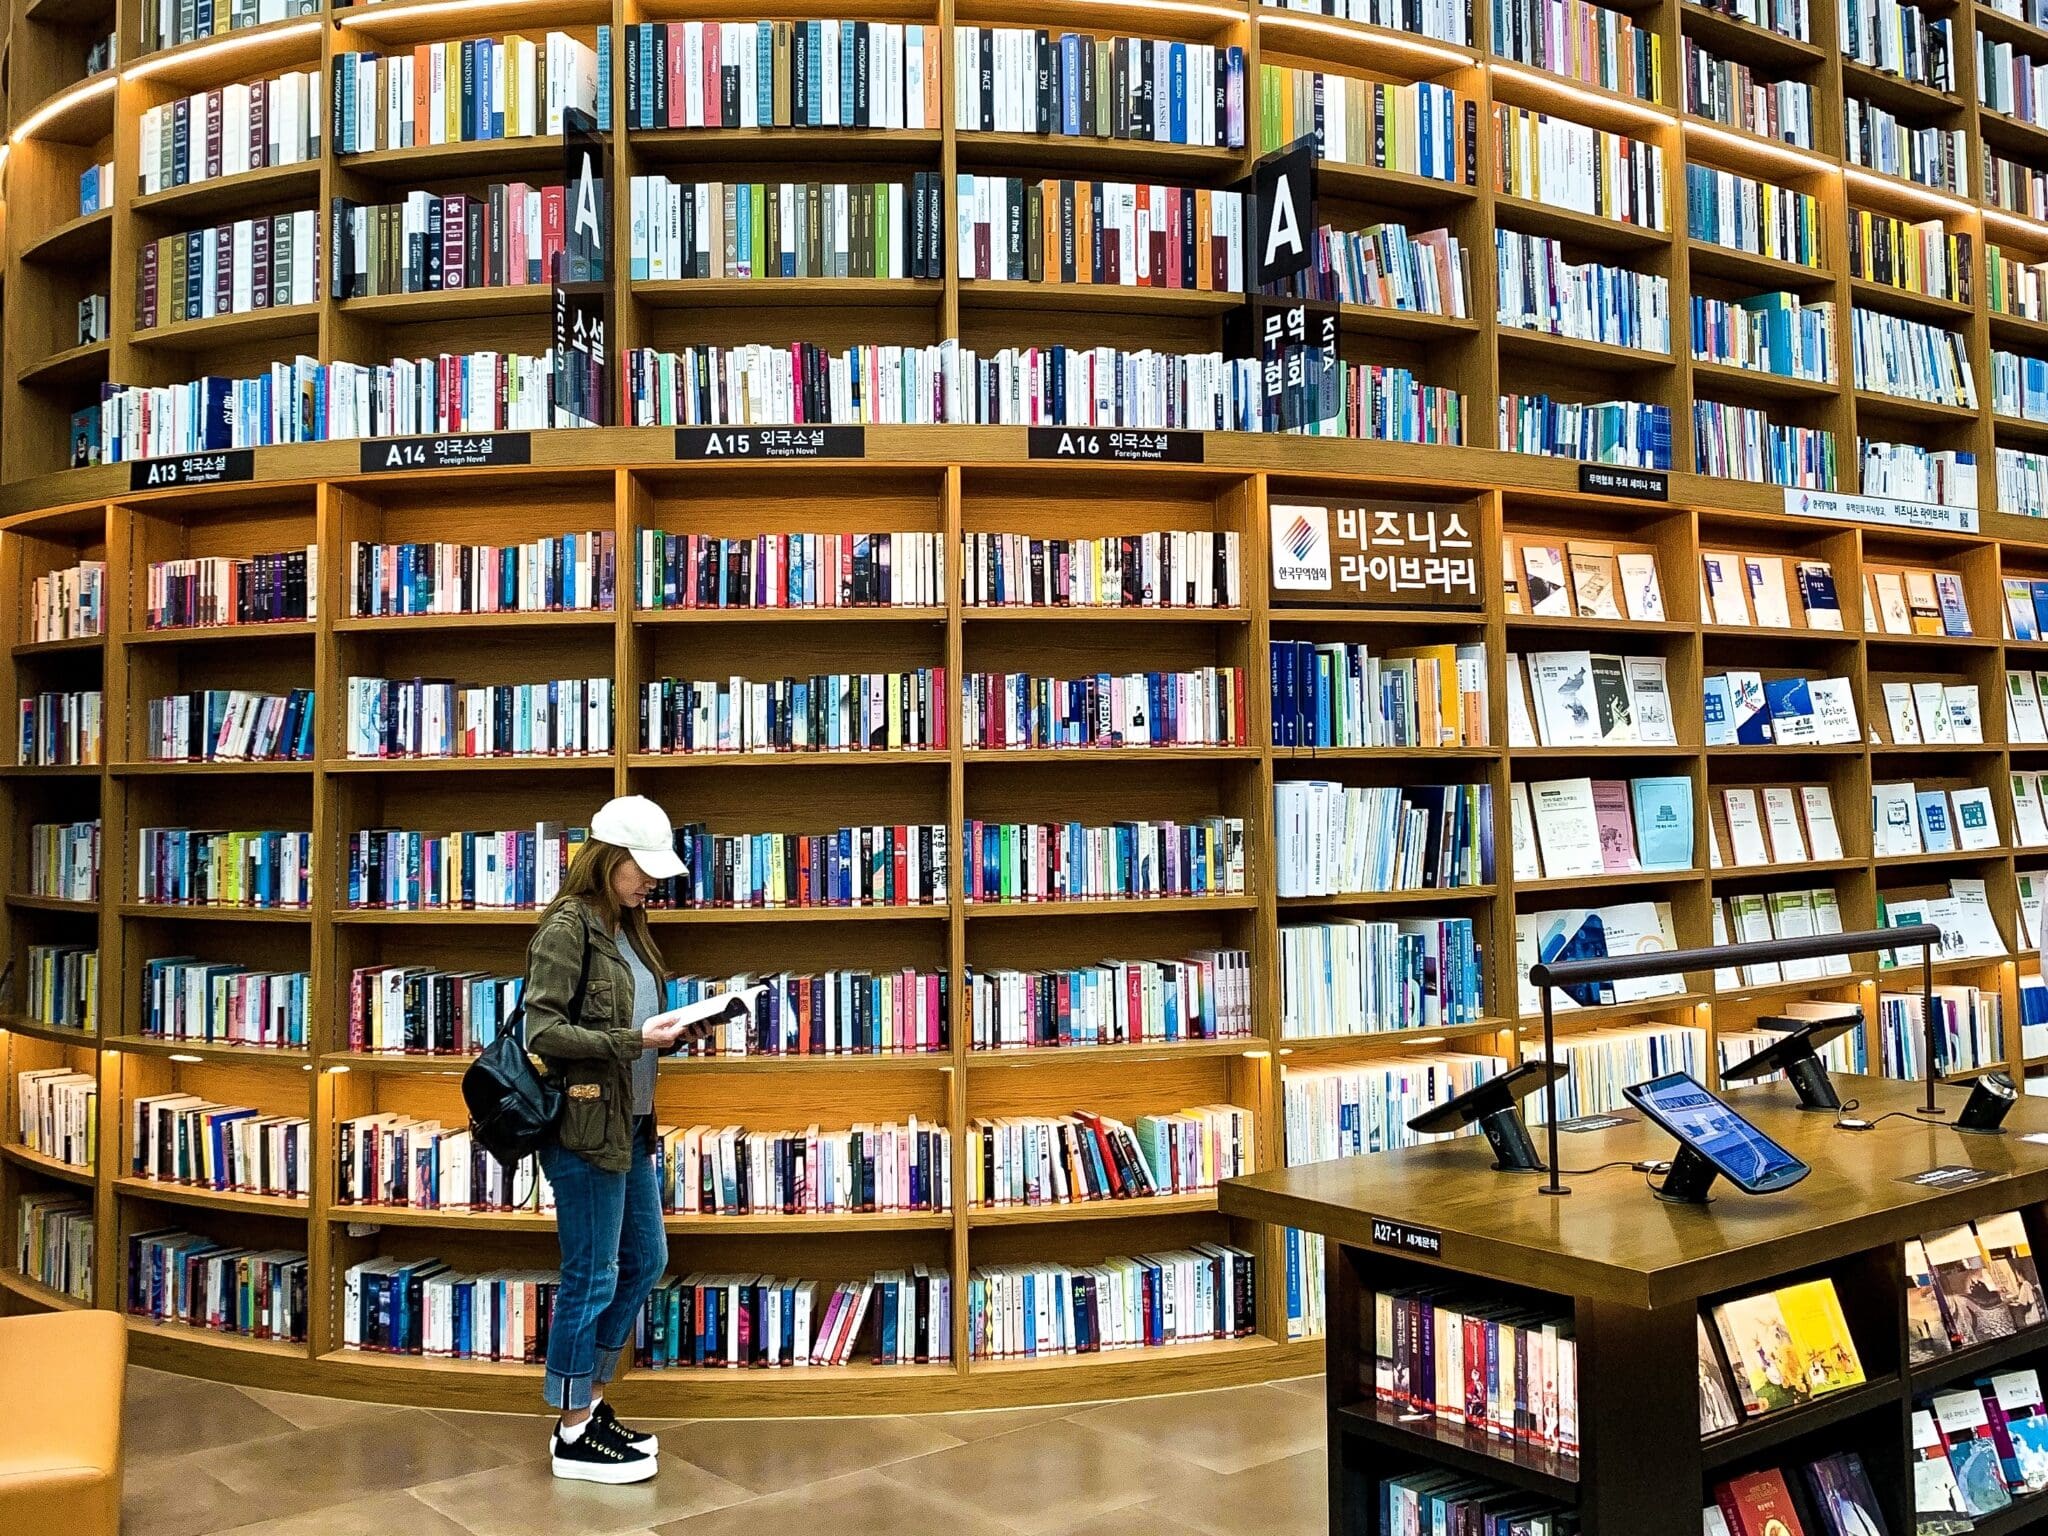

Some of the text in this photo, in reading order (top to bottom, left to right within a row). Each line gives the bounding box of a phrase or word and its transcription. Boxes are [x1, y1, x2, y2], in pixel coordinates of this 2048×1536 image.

[464, 45, 472, 95] FRIENDSHIP
[982, 70, 990, 90] FACE
[1040, 70, 1048, 90] FACE
[575, 151, 600, 249] A
[1264, 174, 1303, 267] A
[556, 288, 566, 371] Fiction
[1264, 304, 1305, 350] 무역
[1322, 316, 1335, 373] KITA
[1264, 351, 1305, 397] 협회
[434, 437, 494, 457] 외국소설
[704, 432, 750, 455] A15
[759, 429, 825, 447] 외국소설
[1057, 433, 1100, 455] A16
[1108, 432, 1169, 451] 외국소설
[385, 444, 426, 466] A14
[439, 454, 486, 466] Foreign Novel
[766, 446, 818, 457] Foreign Novel
[1115, 449, 1162, 460] Foreign Novel
[147, 464, 177, 485] A13
[182, 454, 226, 473] 외국소설
[1894, 505, 1950, 521] 비즈니스 라이브러리
[1337, 508, 1473, 553] 비즈니스
[1279, 566, 1327, 581] 한국무역협회
[1339, 555, 1476, 594] 라이브러리
[1100, 693, 1110, 737] FREEDOM
[1374, 1223, 1438, 1251] A27-1 세계문학
